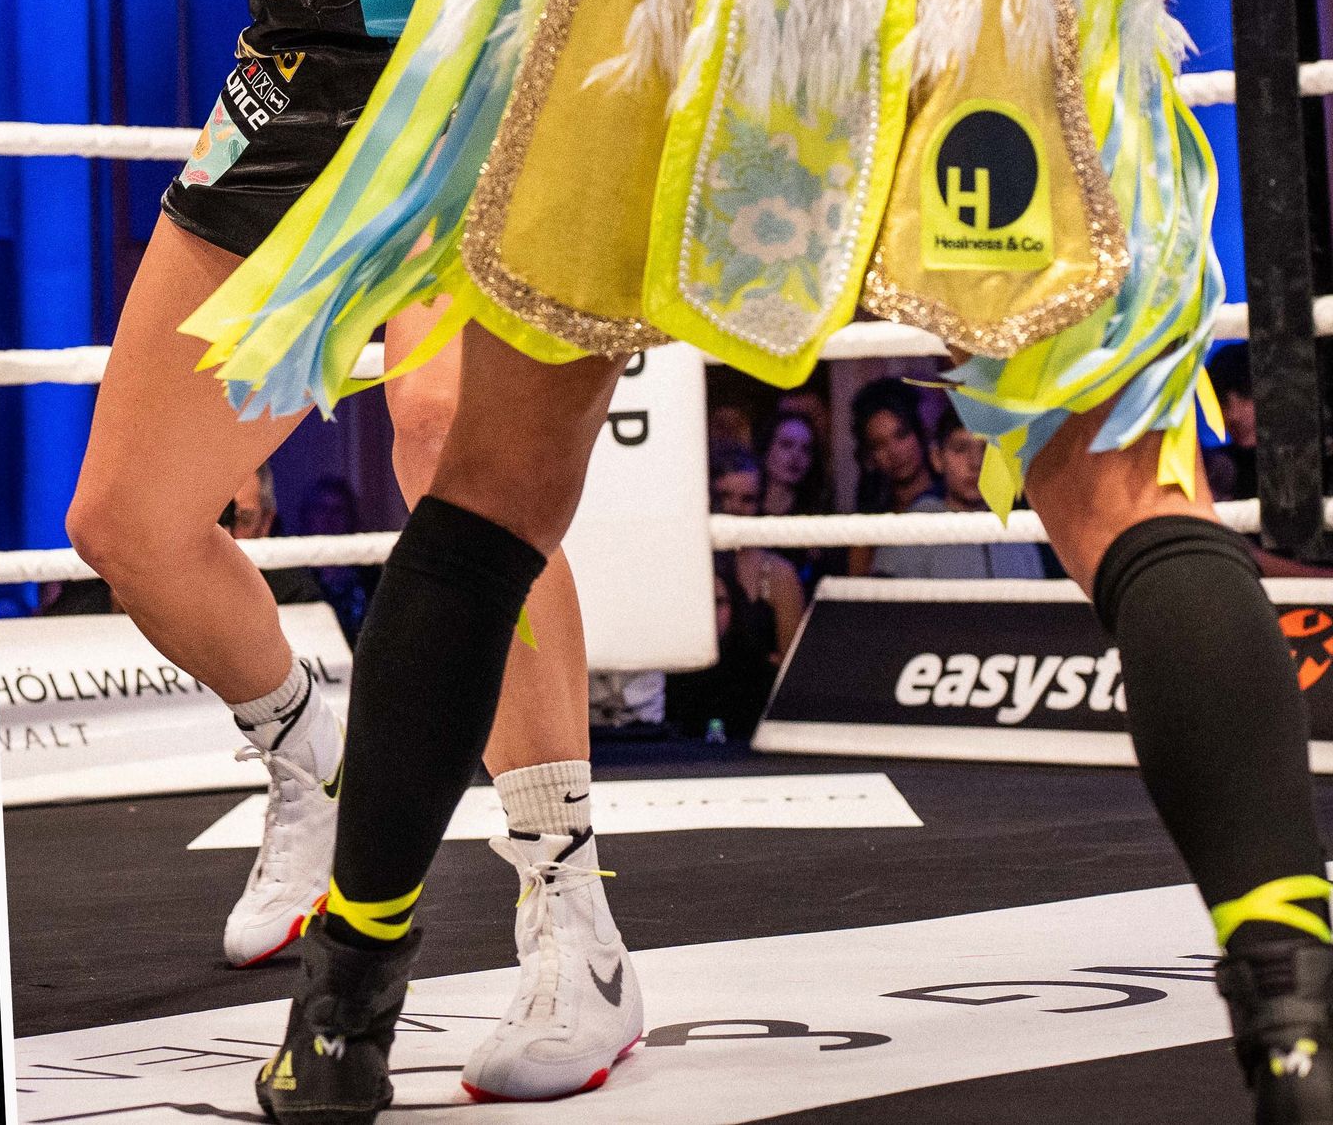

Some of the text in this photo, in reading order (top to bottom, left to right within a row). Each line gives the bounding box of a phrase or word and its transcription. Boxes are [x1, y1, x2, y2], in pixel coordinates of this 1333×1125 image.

[934, 234, 1044, 252] Healness & Co
